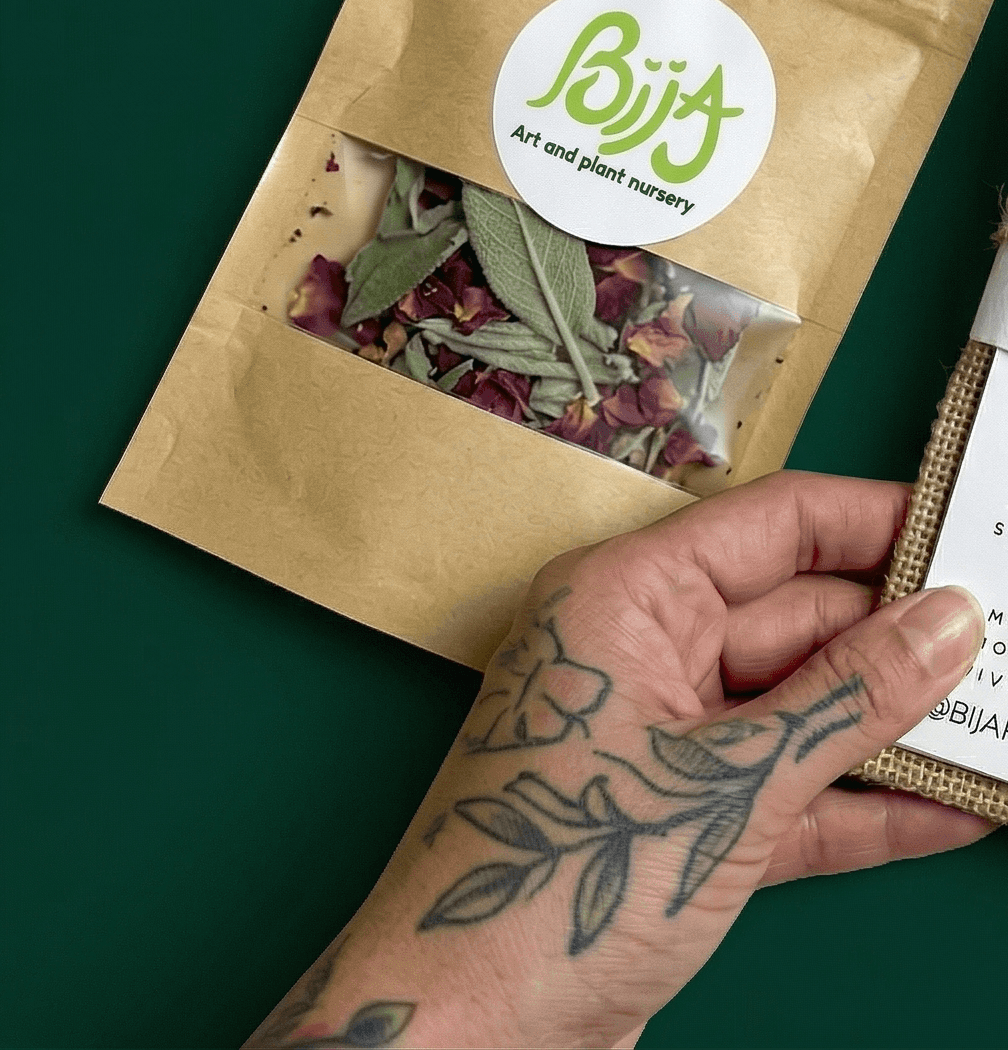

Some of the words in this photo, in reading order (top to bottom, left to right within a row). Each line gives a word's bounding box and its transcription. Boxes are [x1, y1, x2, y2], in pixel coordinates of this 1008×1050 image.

[510, 124, 541, 148] Art
[543, 141, 580, 164] and
[577, 155, 626, 184] plant
[627, 176, 696, 216] nursery
